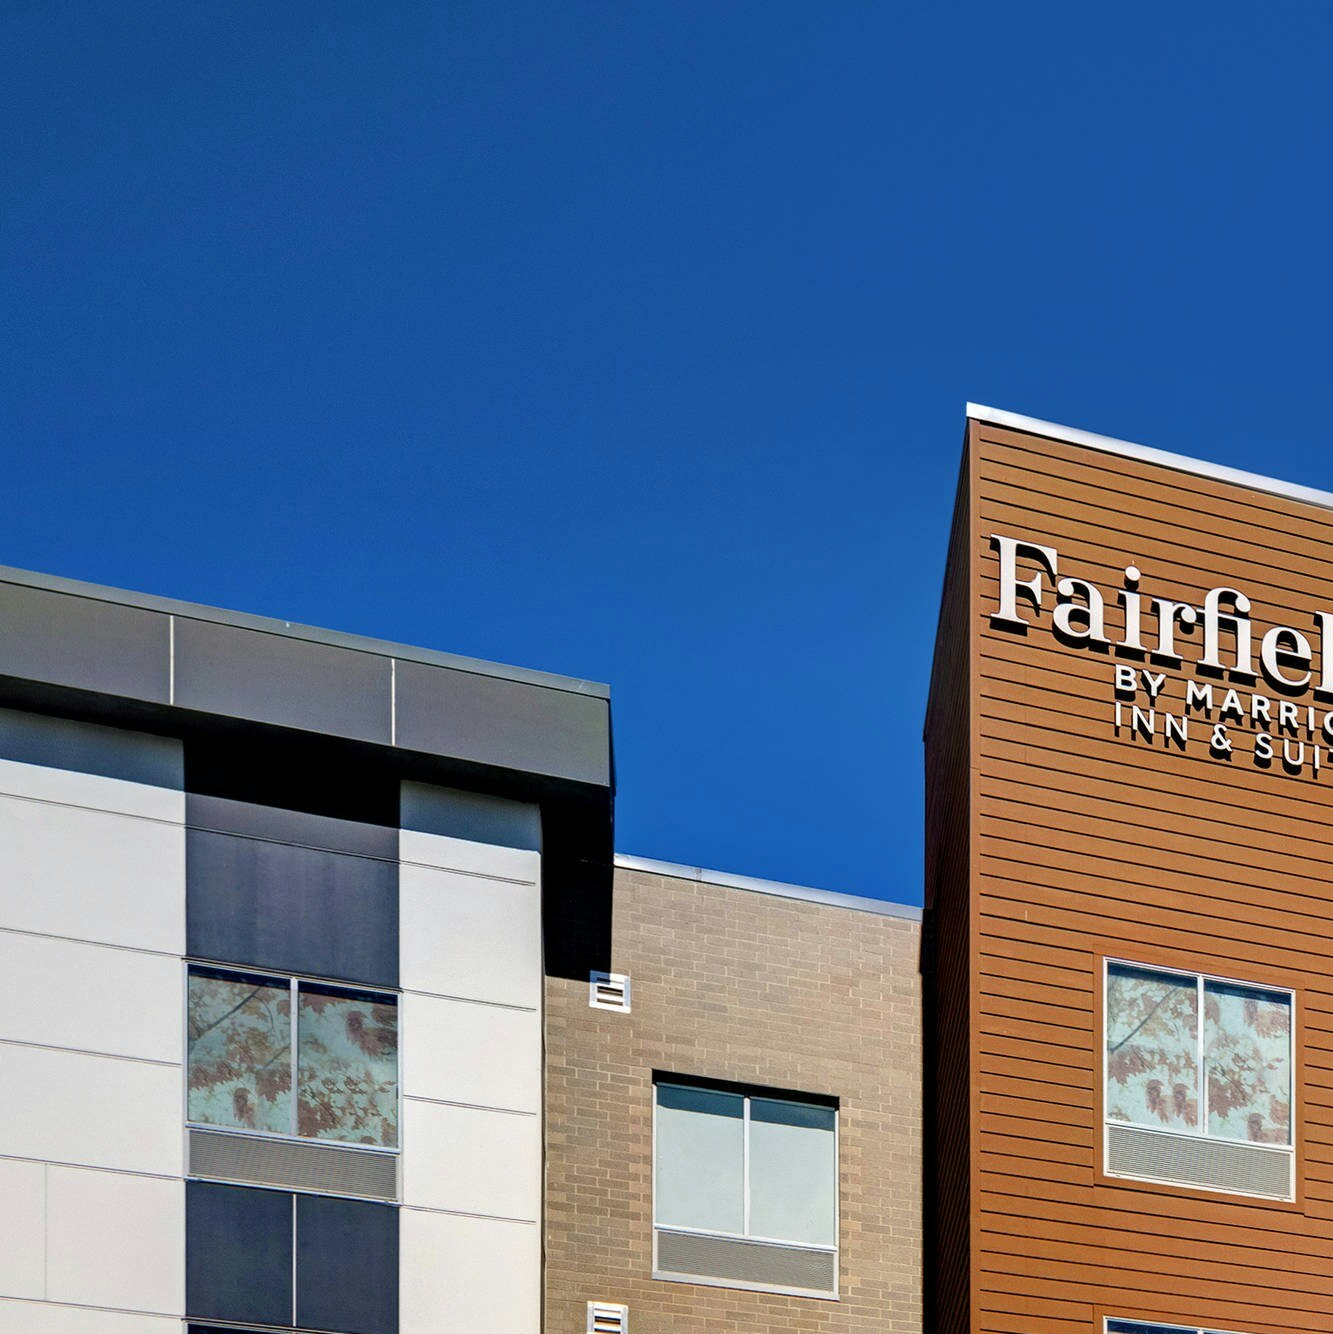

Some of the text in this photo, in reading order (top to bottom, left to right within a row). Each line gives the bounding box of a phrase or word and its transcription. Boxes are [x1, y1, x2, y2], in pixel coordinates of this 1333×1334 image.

[1115, 663, 1167, 697] BY
[1115, 701, 1188, 741] INN
[1210, 723, 1233, 753] &
